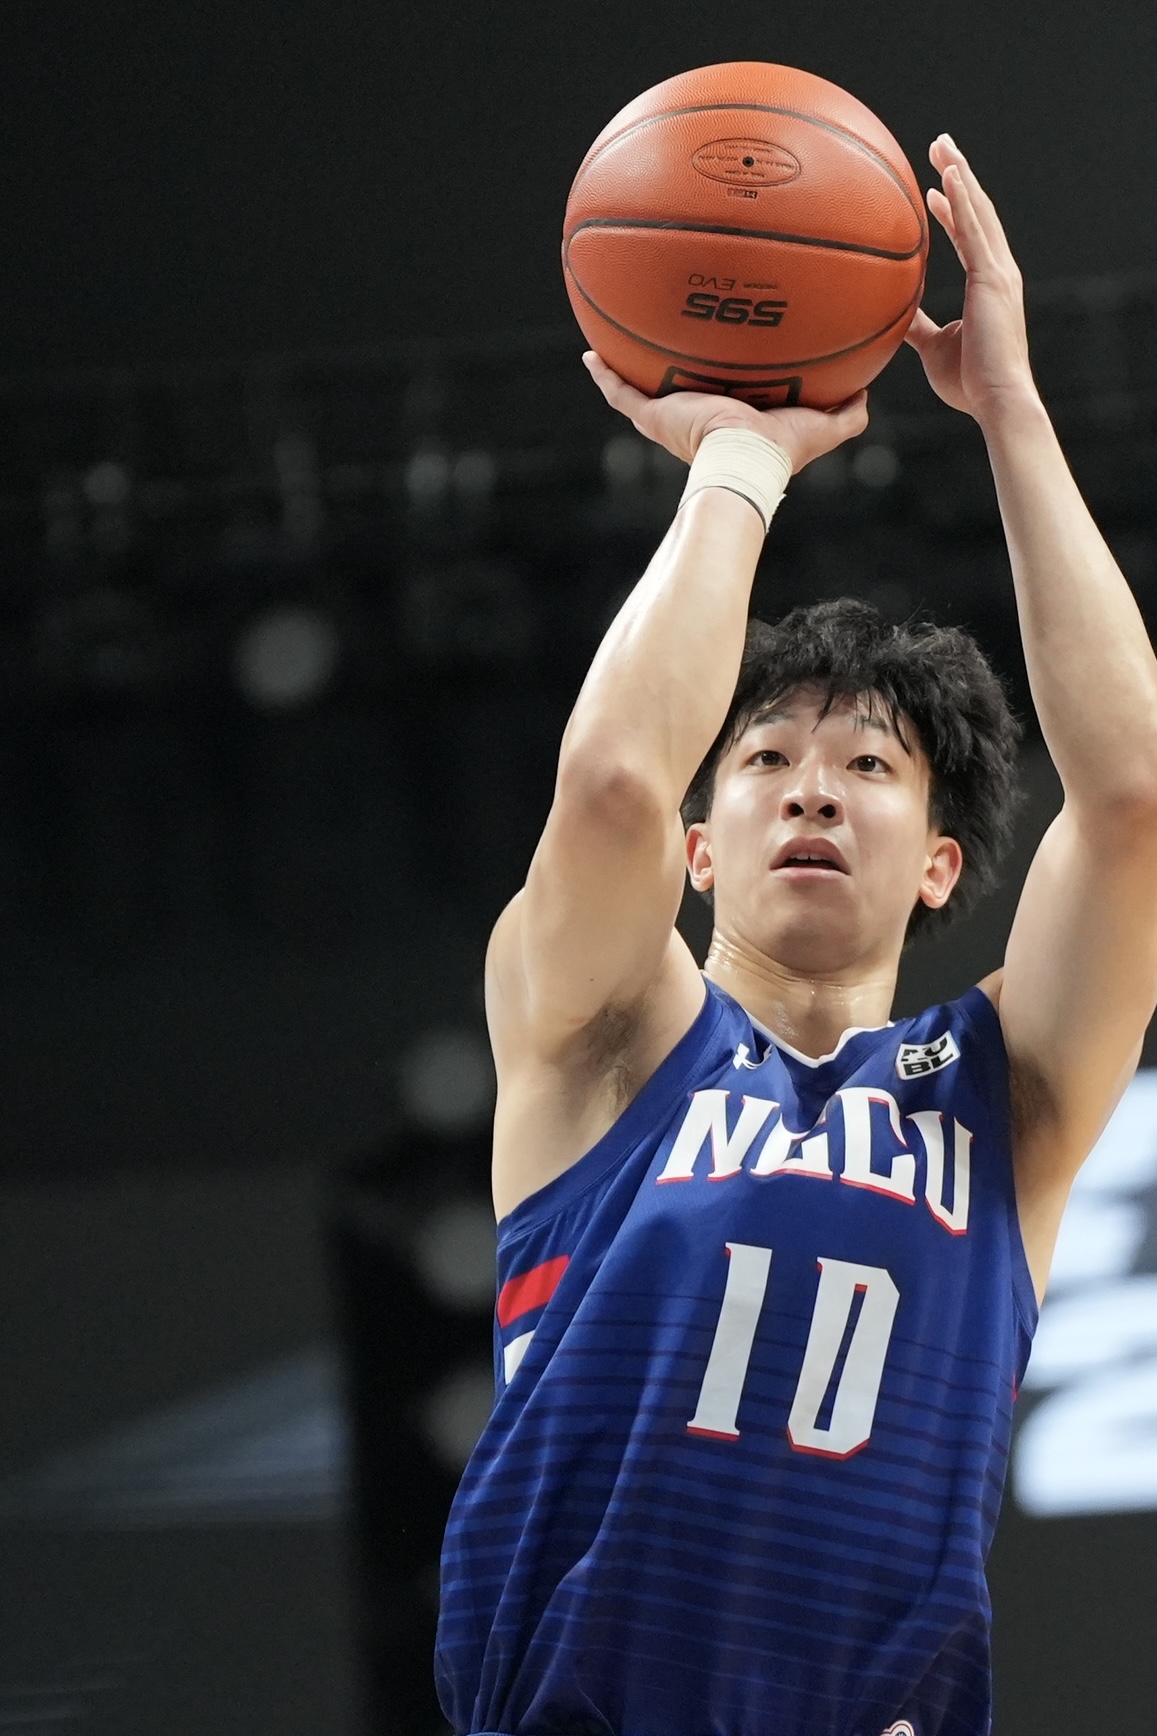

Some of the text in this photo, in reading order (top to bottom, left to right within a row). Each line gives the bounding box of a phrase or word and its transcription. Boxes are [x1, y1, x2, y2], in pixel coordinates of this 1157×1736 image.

[688, 273, 736, 291] EVO
[681, 292, 789, 327] 595
[687, 1242, 900, 1461] 10
